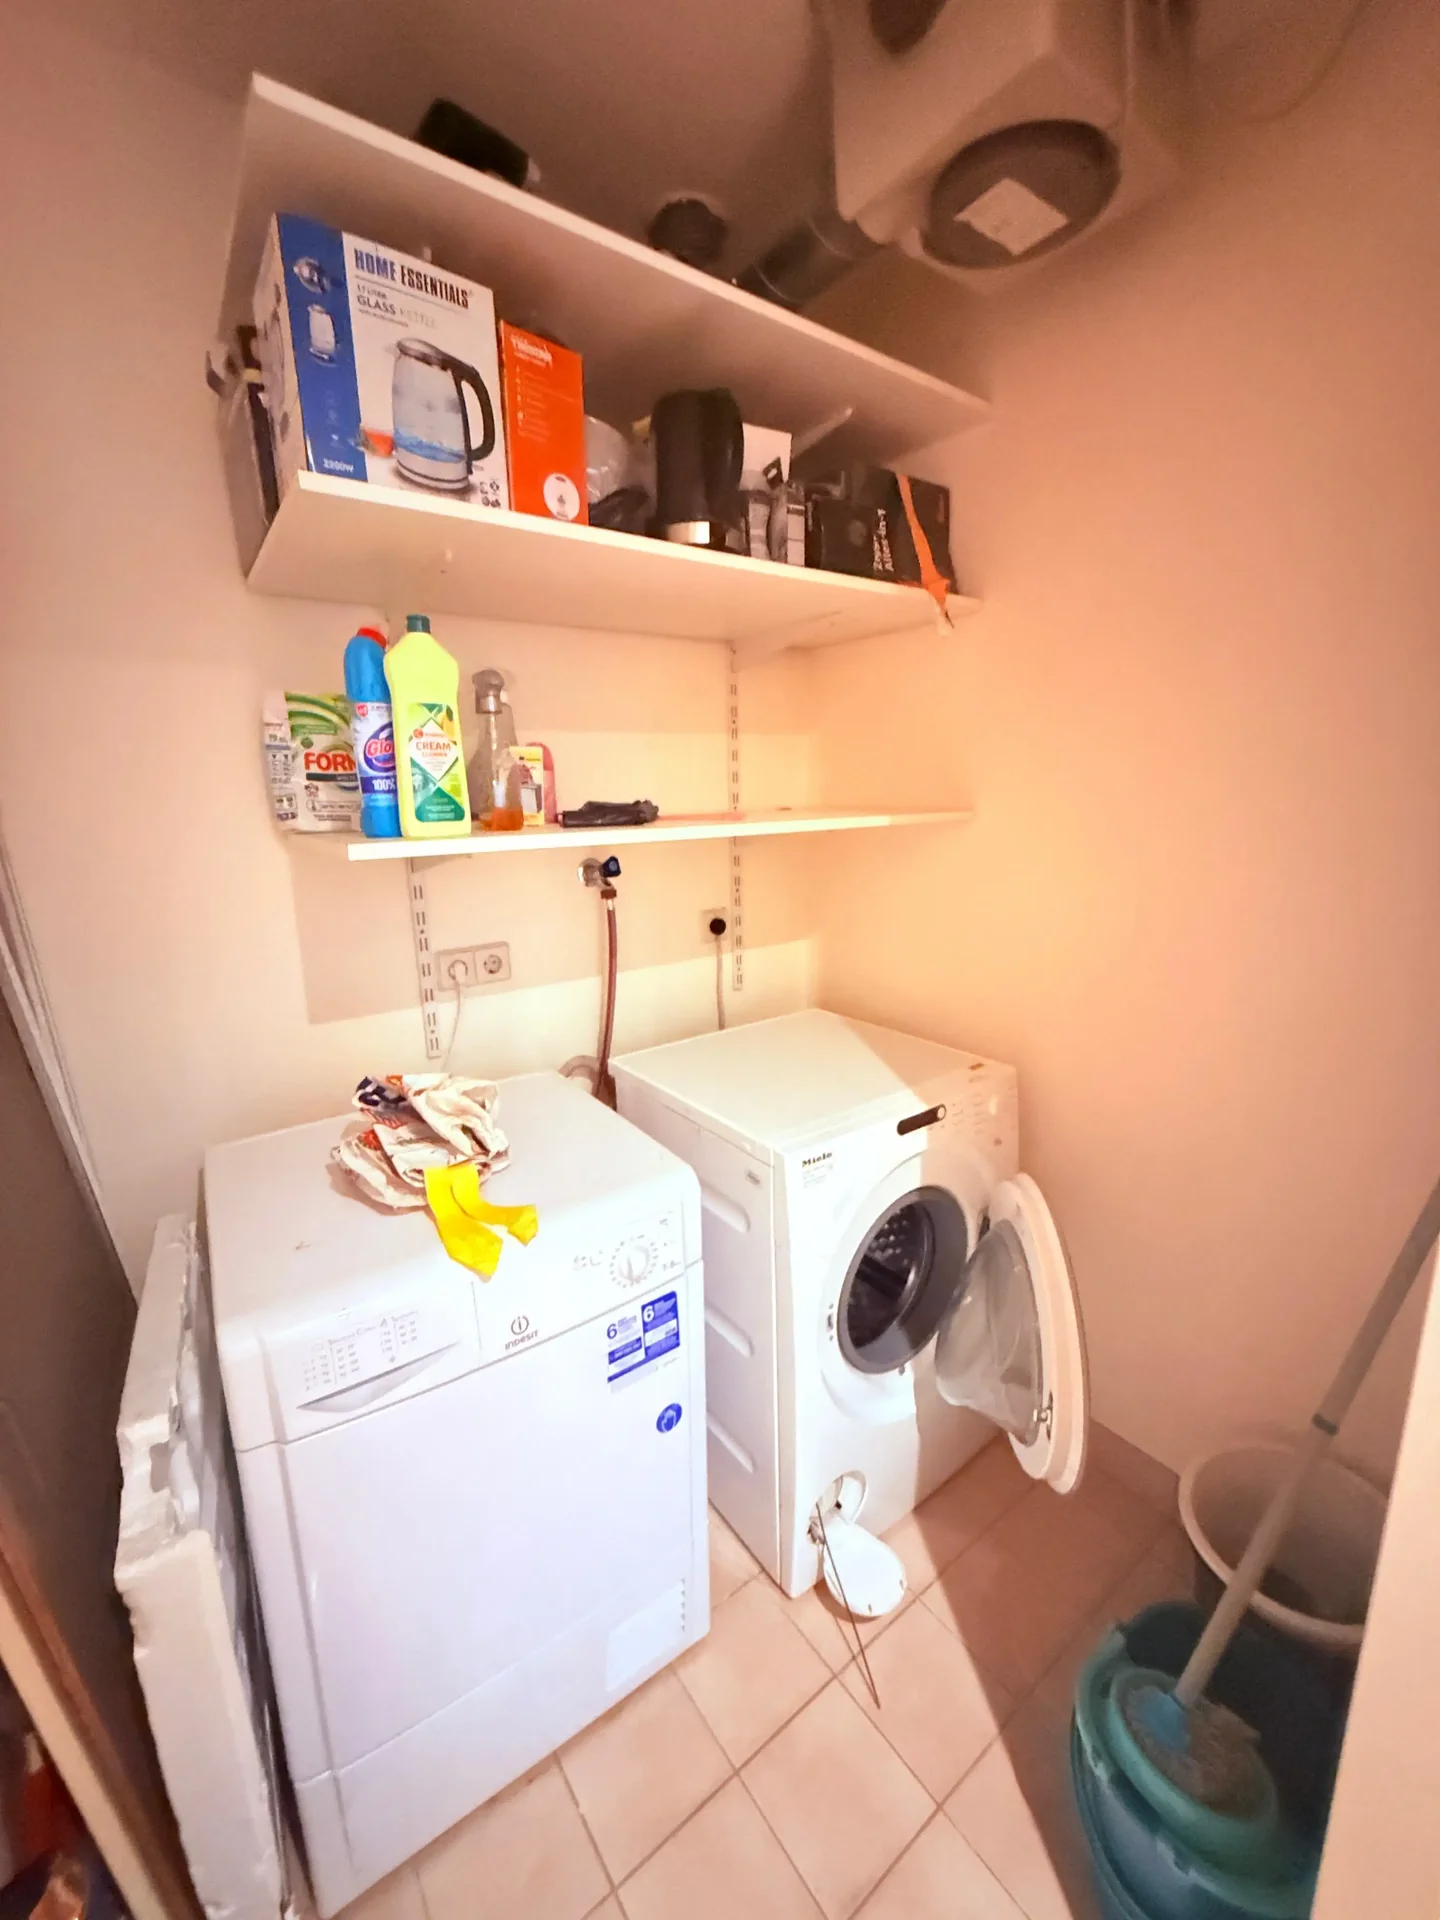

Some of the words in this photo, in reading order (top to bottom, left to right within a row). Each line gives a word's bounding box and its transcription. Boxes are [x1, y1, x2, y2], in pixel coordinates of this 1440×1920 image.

[354, 248, 397, 282] HOME
[401, 265, 469, 309] ESSENTIALS
[357, 295, 396, 316] GLASS
[365, 739, 394, 757] Glo
[416, 741, 451, 751] CREAM
[372, 778, 396, 791] 100%
[802, 1152, 832, 1168] Miele
[643, 1305, 655, 1322] 6
[607, 1323, 617, 1340] 6
